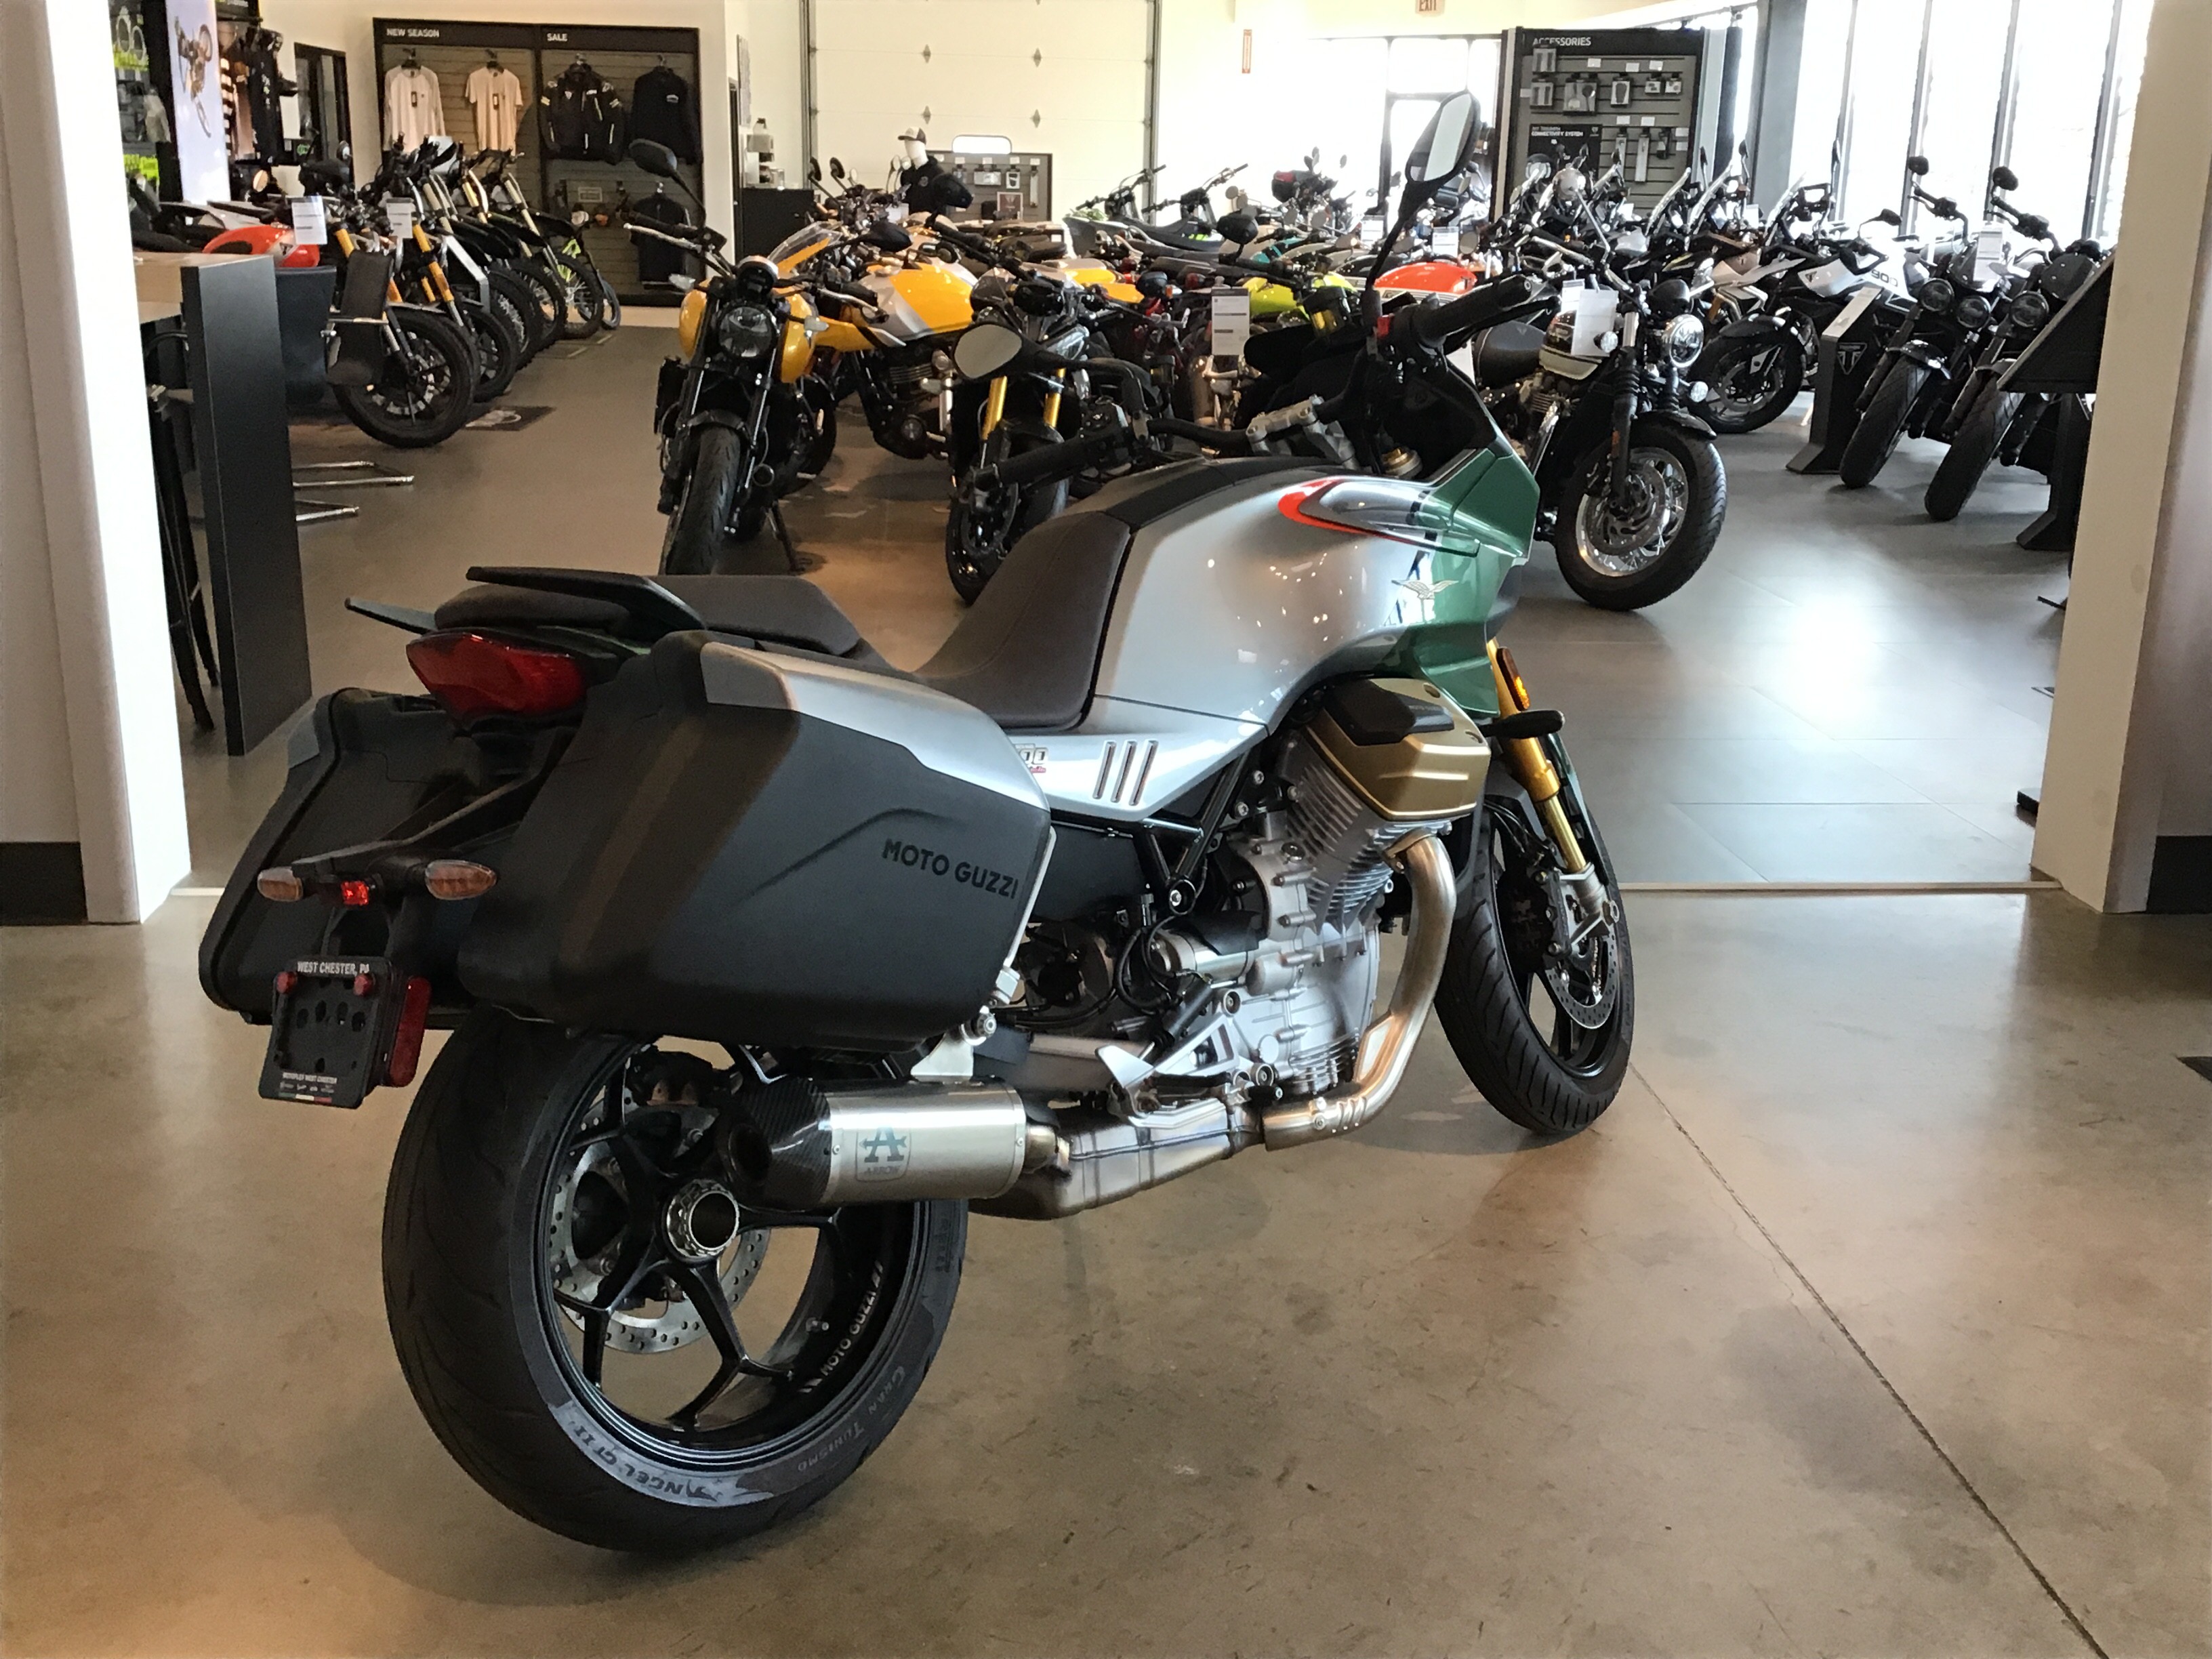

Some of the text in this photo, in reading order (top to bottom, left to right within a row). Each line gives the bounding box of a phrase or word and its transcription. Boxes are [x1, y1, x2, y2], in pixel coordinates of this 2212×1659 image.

[386, 28, 439, 37] NEW SEASON
[547, 33, 567, 41] SALE
[1871, 269, 1898, 287] 900
[882, 838, 1019, 899] MOTO GUZZI
[297, 961, 318, 974] WEST
[319, 962, 357, 977] CHESTER,
[821, 1290, 877, 1376] MOTO GUZZI
[593, 1446, 617, 1465] GT
